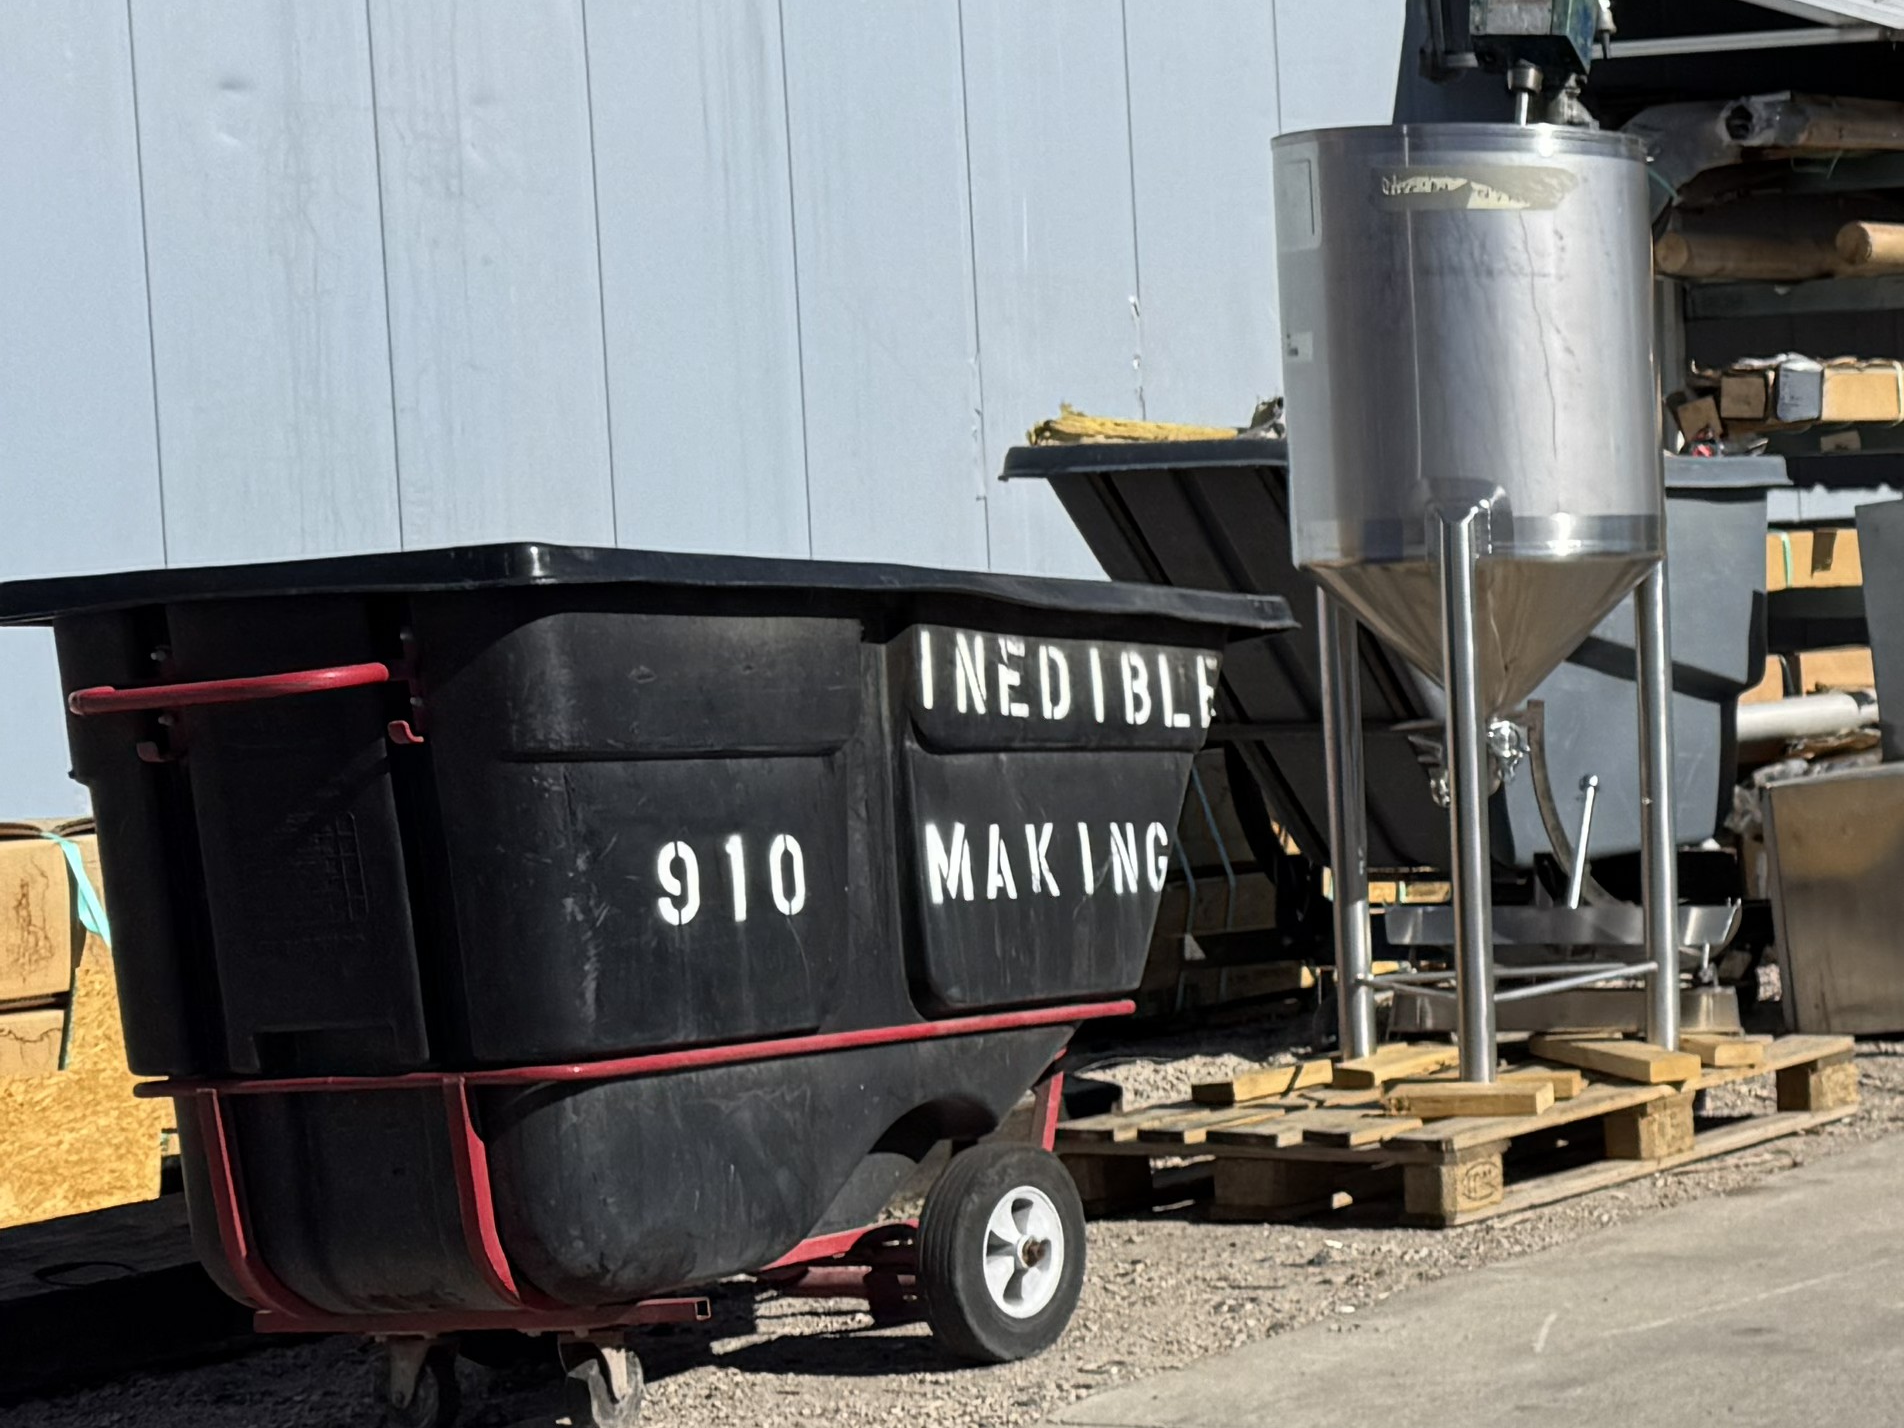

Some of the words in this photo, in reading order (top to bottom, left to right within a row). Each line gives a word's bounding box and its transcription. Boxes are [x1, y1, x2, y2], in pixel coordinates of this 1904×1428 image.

[919, 628, 1217, 728] INEDIBLE
[656, 832, 807, 926] 910
[925, 820, 1168, 905] MAKING
